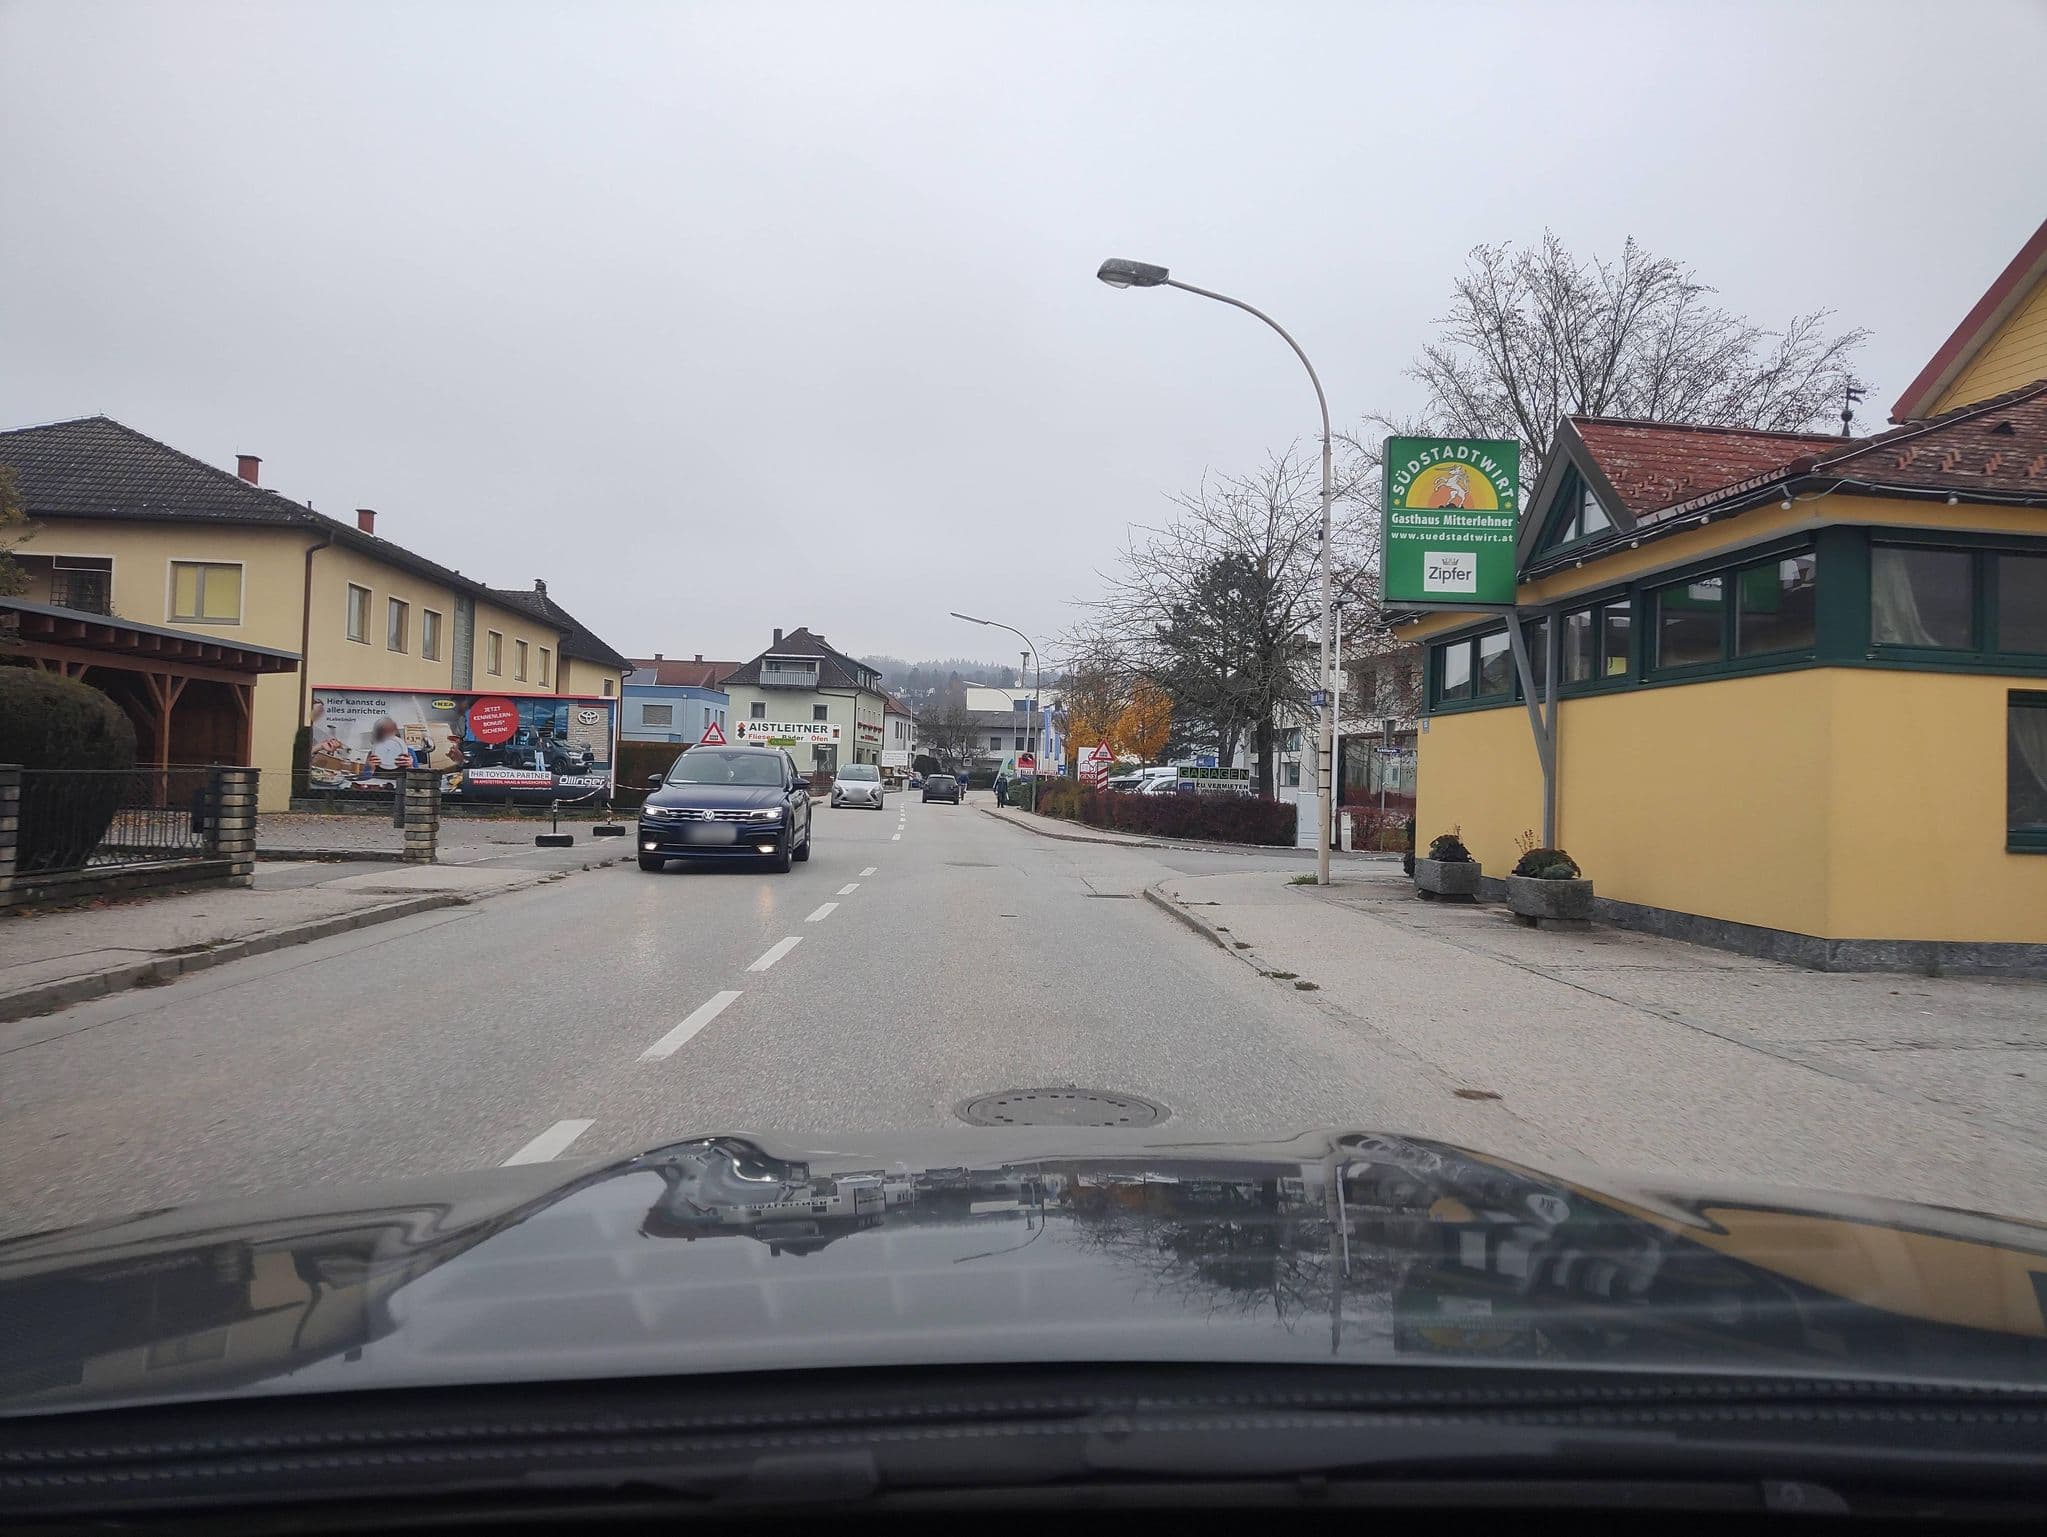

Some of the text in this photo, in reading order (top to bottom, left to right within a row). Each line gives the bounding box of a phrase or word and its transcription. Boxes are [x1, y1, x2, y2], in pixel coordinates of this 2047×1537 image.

[1392, 445, 1514, 497] SÜDSTADTWIRT
[1391, 513, 1513, 527] Gasthaus Mitterlehner
[1391, 531, 1513, 542] www.suedstadtwirt.at
[1428, 566, 1472, 584] Zipfer
[326, 706, 345, 714] alles
[749, 723, 829, 734] AISTLEITNER
[471, 770, 550, 779] IHR TOYOTA PARTNER
[1180, 767, 1249, 780] GARAGEN
[1206, 782, 1249, 790] VERMIETEN
